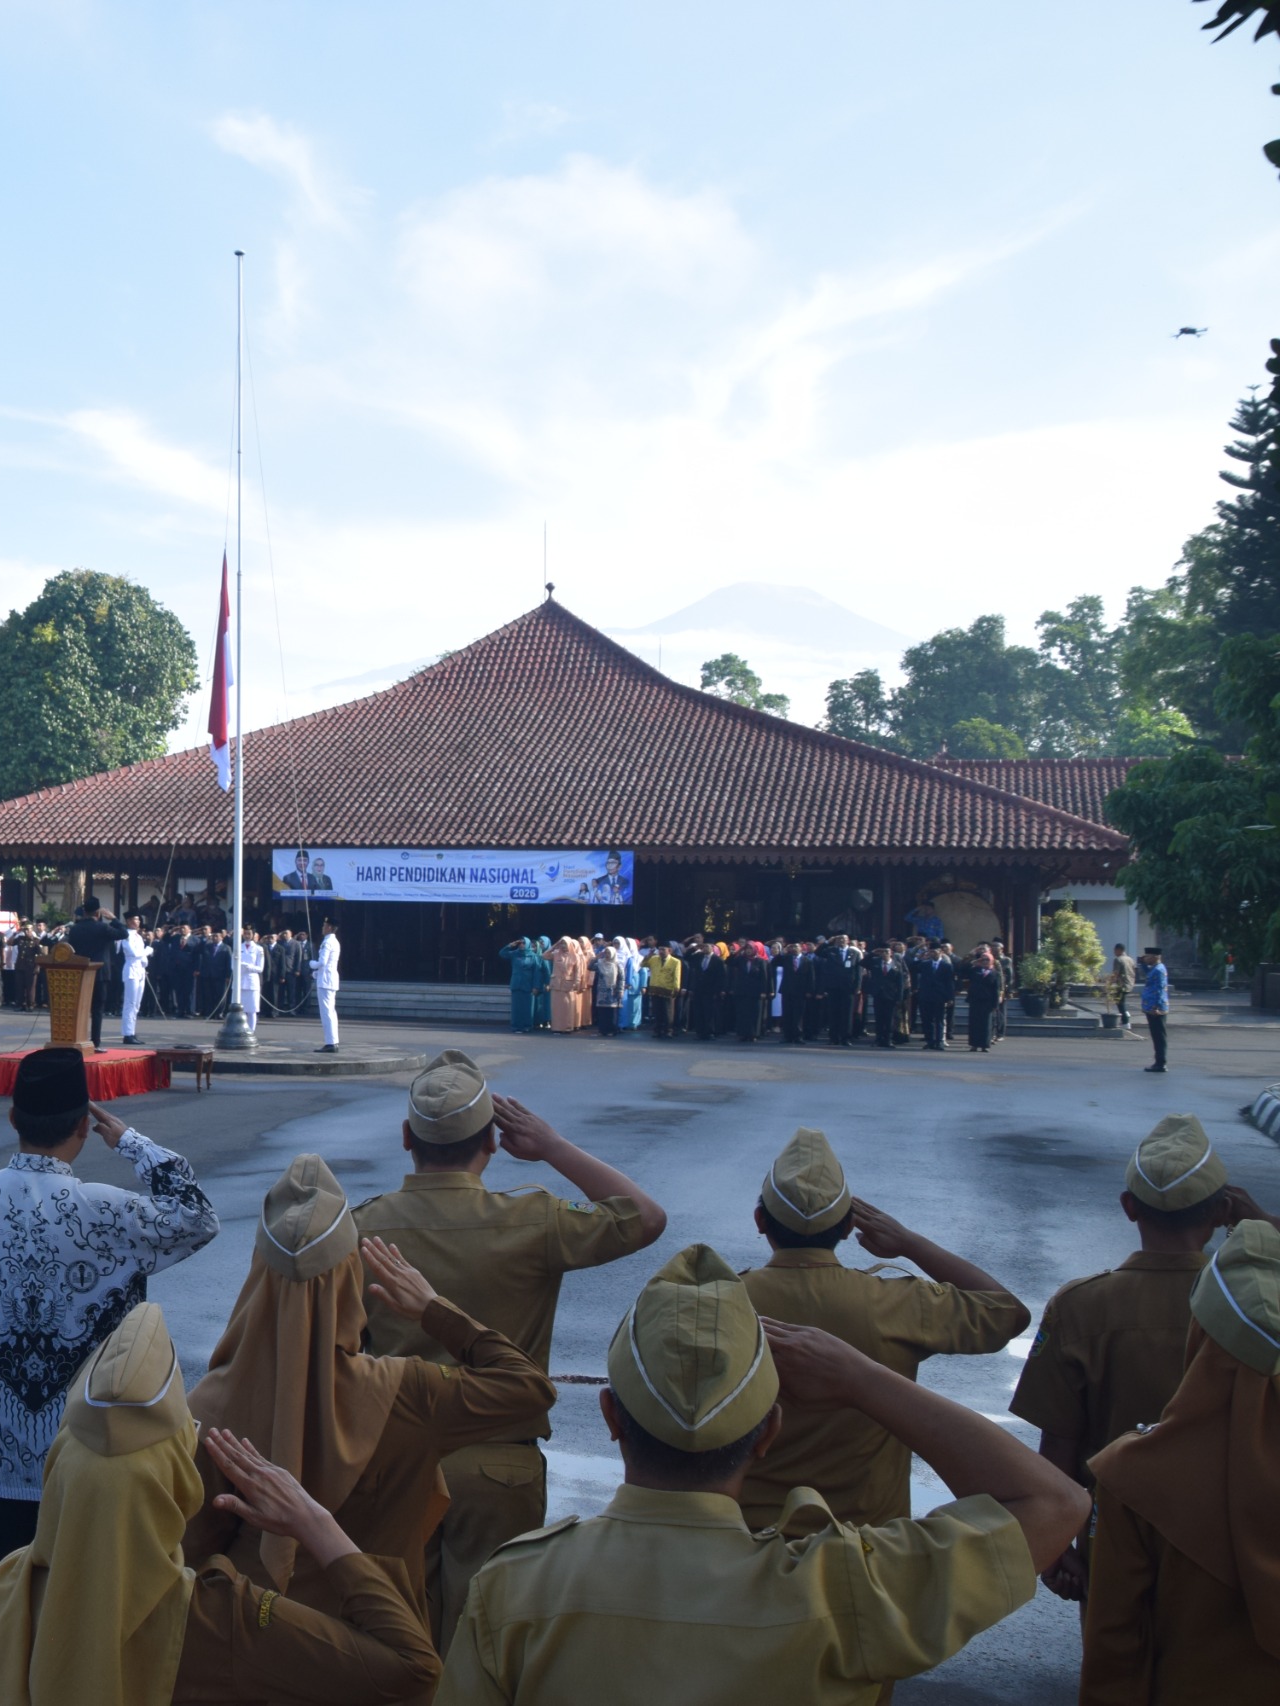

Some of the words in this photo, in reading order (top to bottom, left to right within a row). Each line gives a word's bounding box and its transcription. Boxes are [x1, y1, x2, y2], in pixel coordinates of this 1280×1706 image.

[356, 866, 386, 882] HARI
[389, 866, 466, 883] PENDIDIKAN
[470, 867, 537, 884] NASIONAL
[512, 887, 536, 898] 2026
